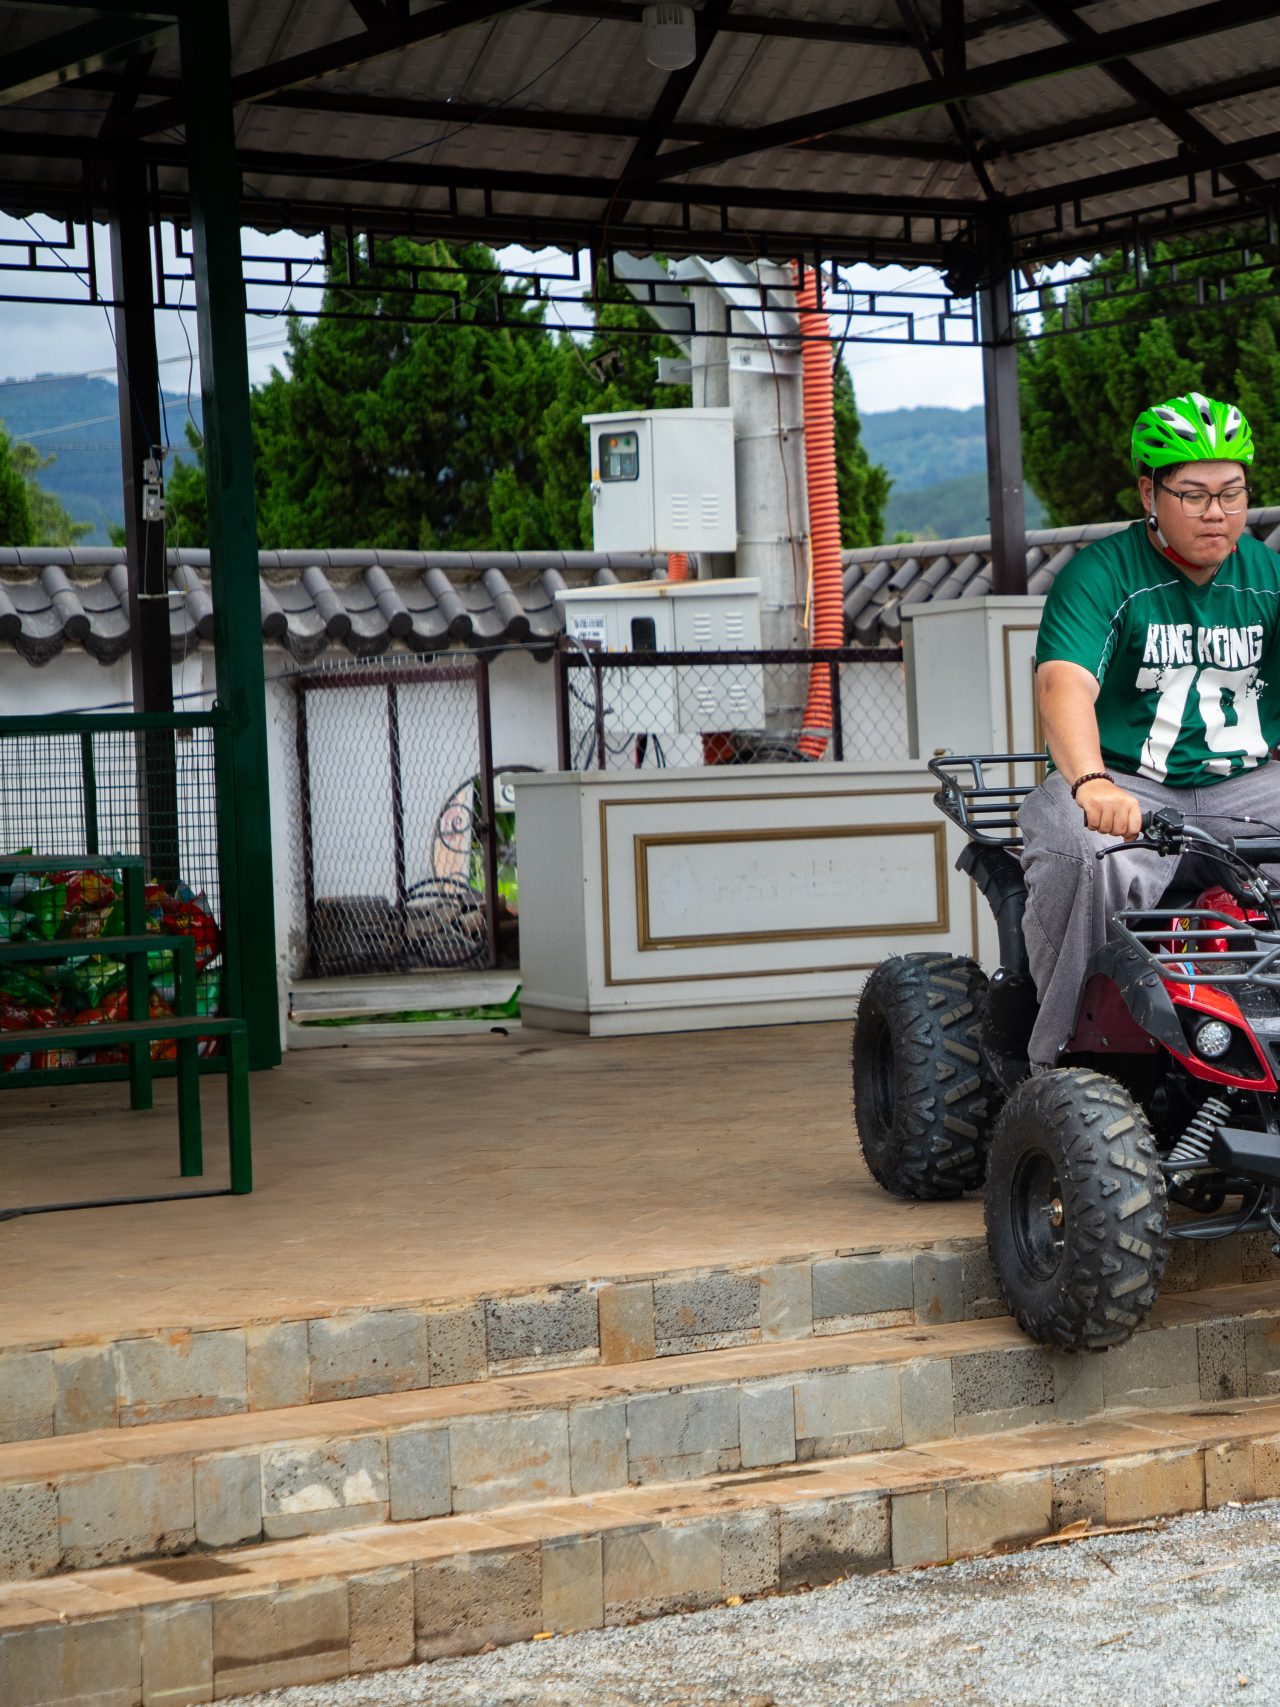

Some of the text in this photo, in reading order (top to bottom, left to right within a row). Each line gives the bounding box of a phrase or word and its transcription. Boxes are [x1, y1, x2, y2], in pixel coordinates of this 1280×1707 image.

[1142, 623, 1264, 668] KING KONG
[1135, 665, 1269, 783] 70
